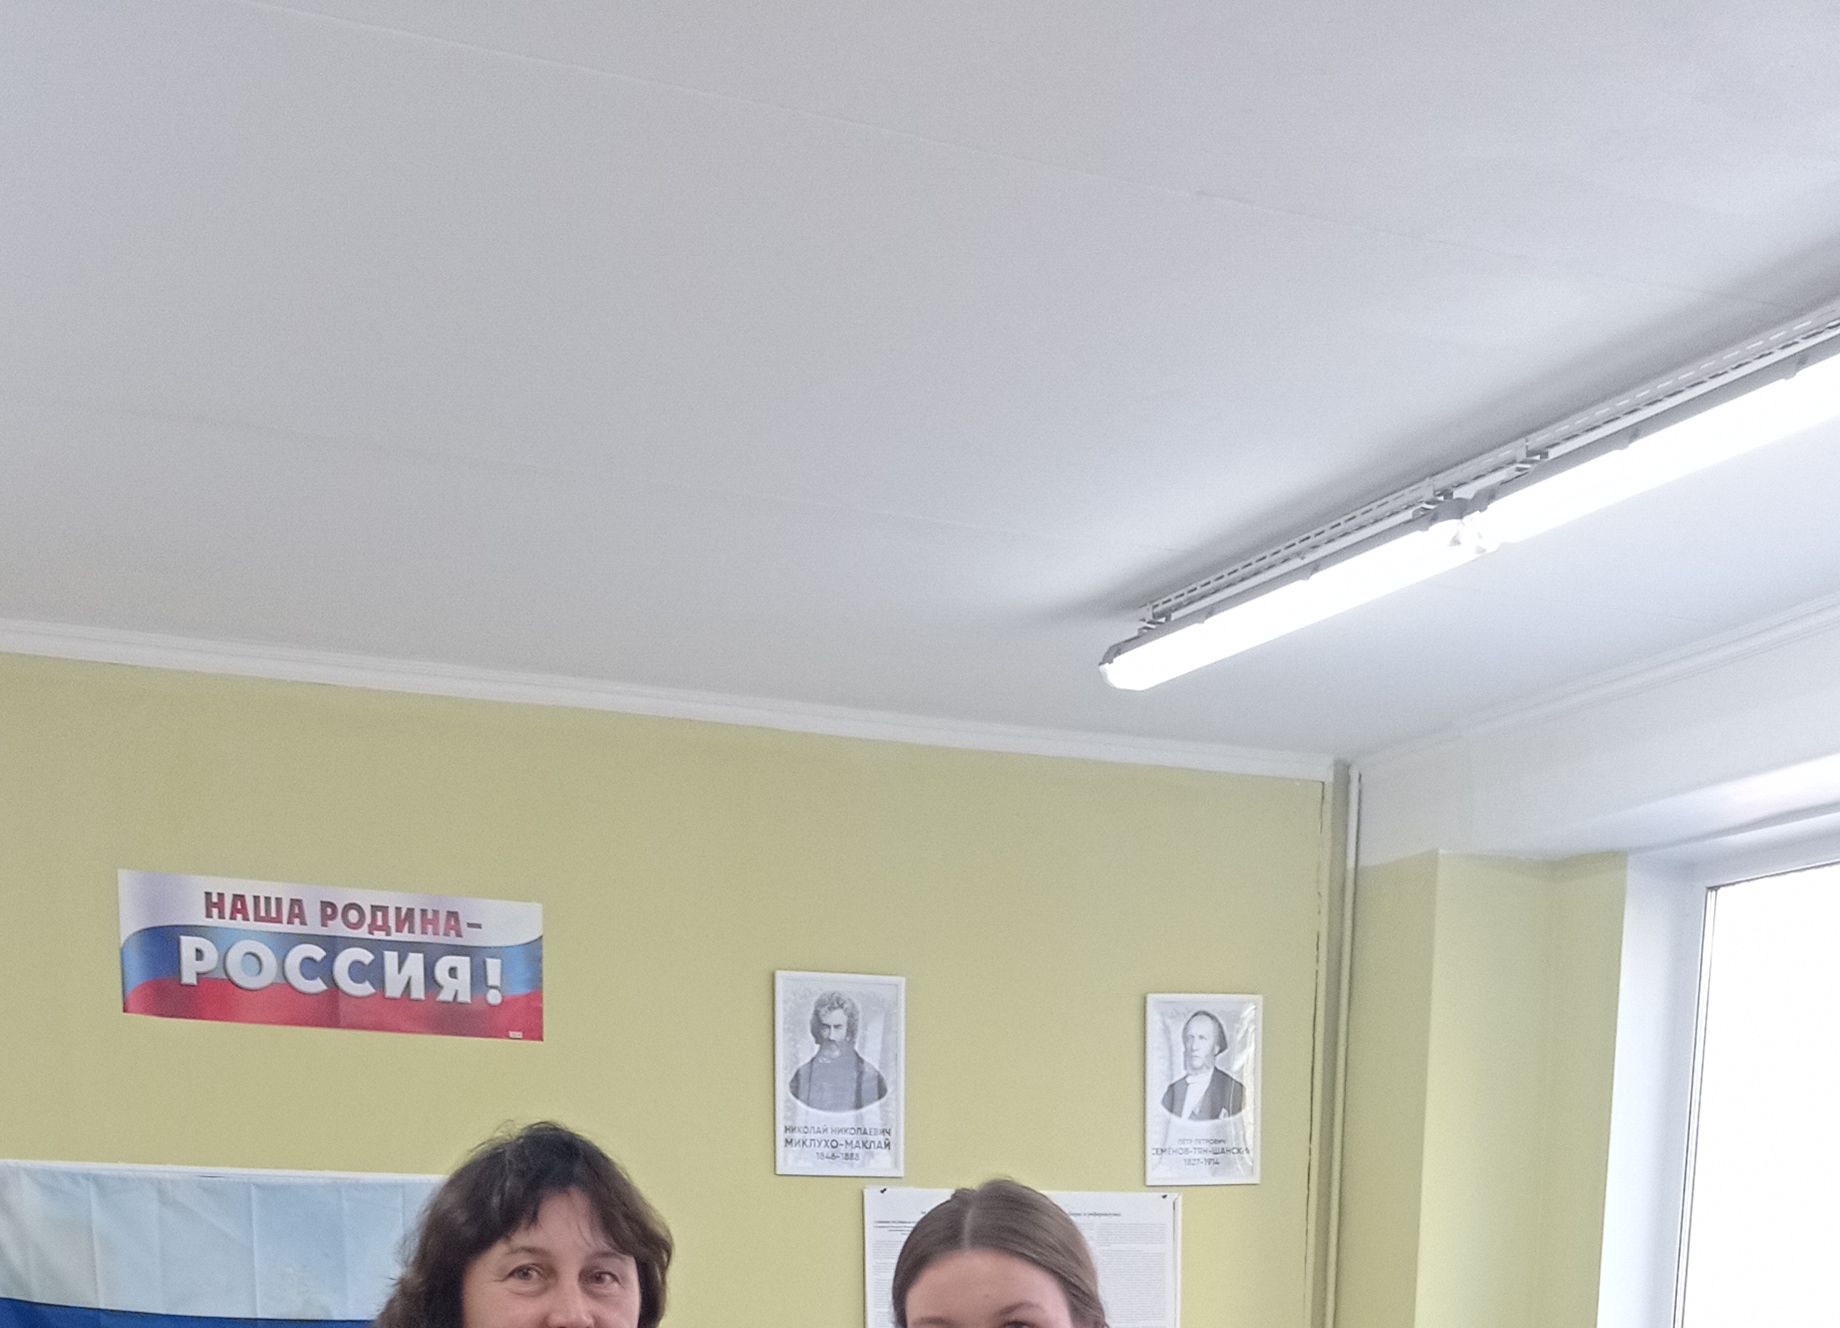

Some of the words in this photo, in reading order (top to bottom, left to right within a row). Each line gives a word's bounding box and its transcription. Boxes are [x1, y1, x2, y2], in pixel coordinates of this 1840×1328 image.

[204, 891, 307, 927] НАША
[179, 935, 504, 1006] РОССИЯ!
[784, 1124, 828, 1134] НИКОЛАЙ
[830, 1126, 891, 1137] НИКОЛАЕВИЧ
[784, 1137, 891, 1150] МИКЛУХО-МАКЛАЙ
